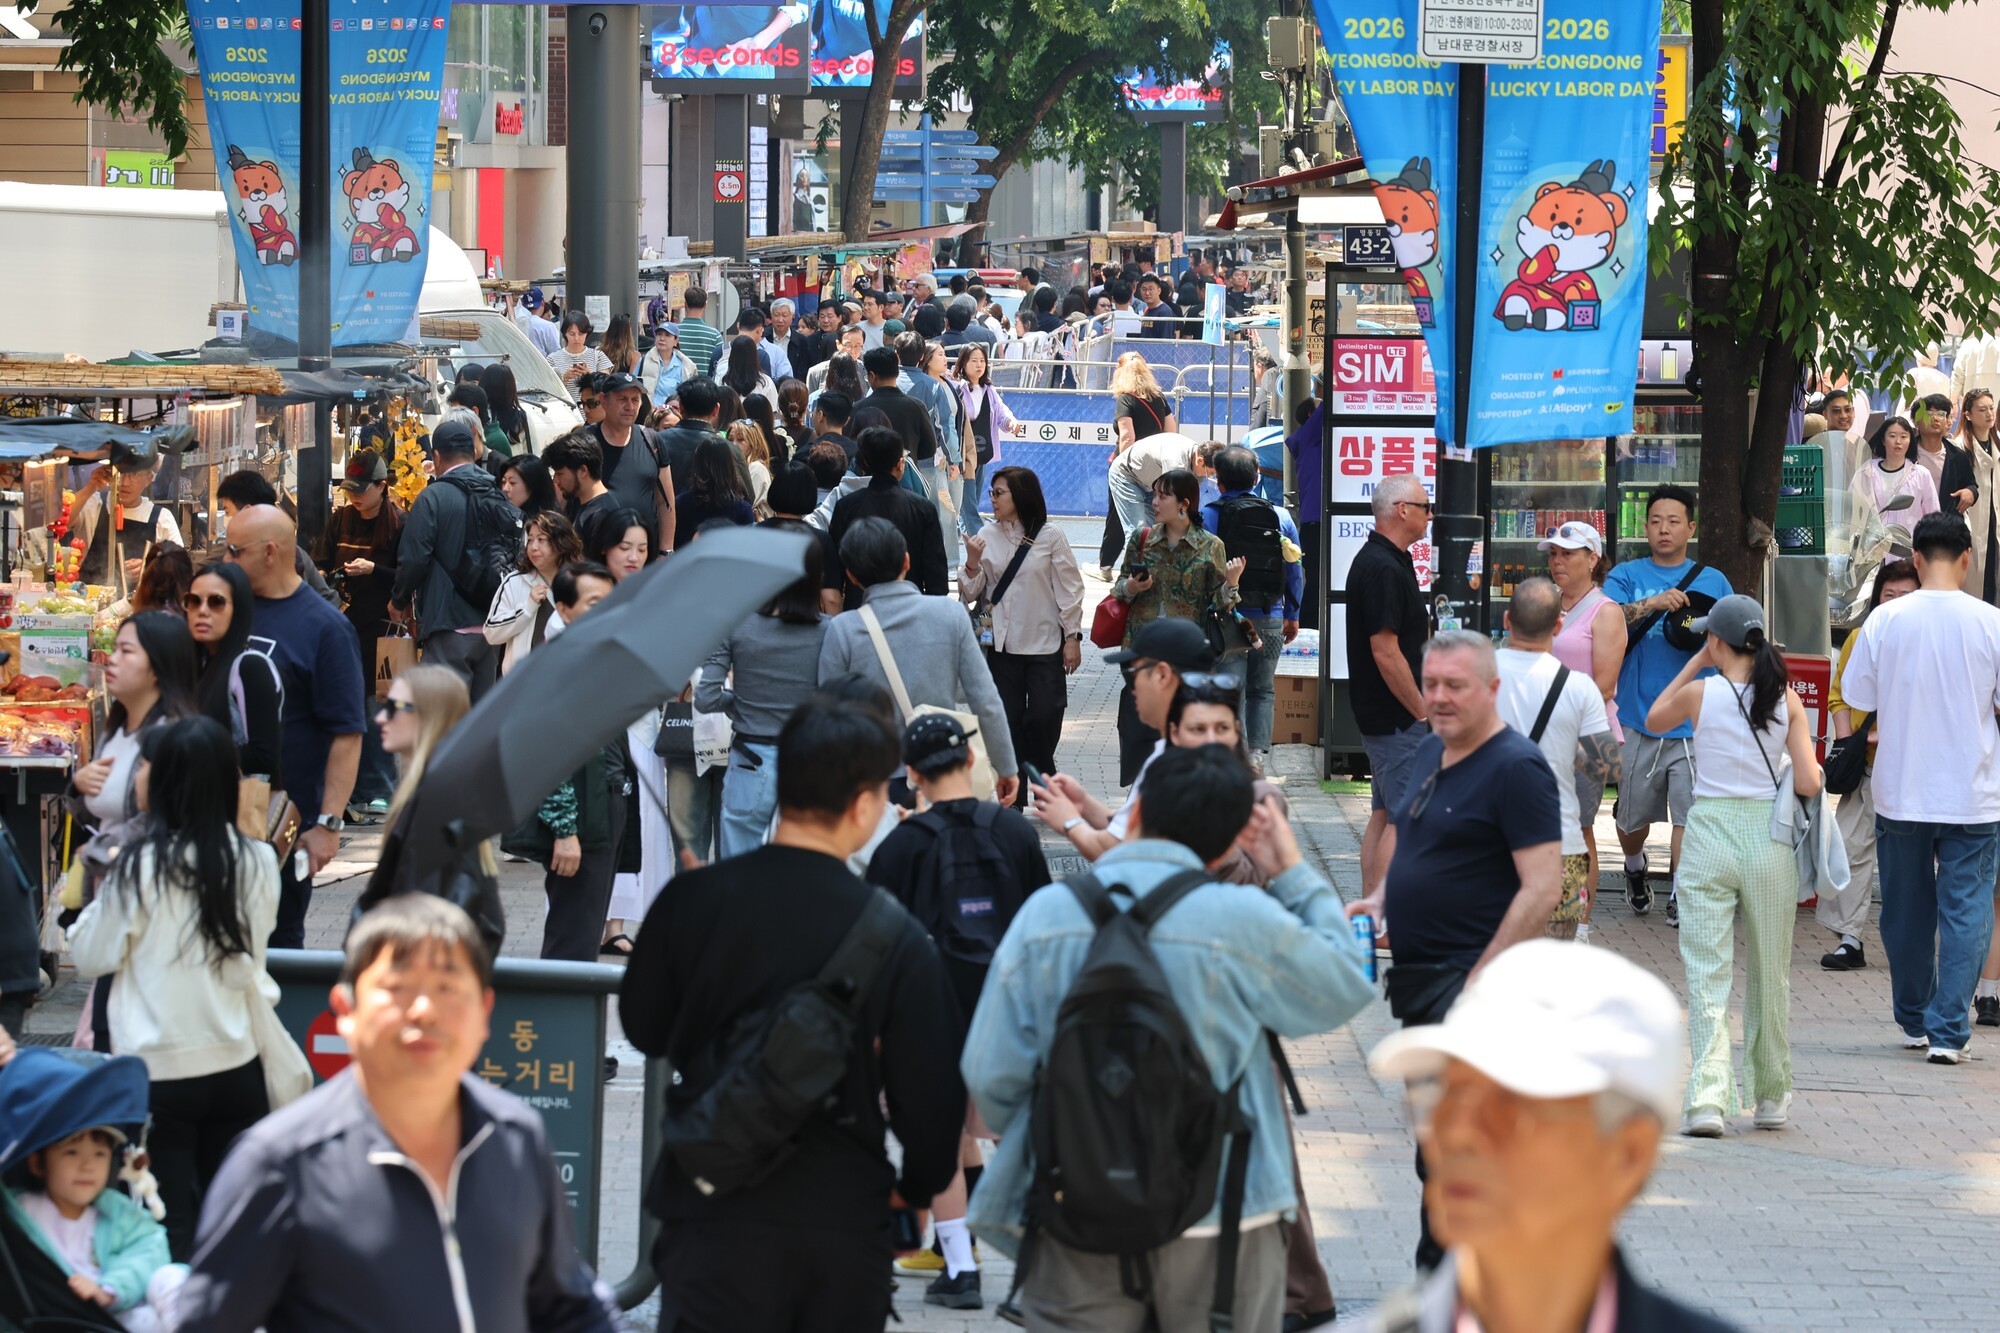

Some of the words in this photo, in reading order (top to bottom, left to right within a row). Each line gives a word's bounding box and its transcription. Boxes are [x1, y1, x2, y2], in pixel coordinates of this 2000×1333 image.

[1344, 17, 1405, 39] 2026
[1545, 18, 1610, 40] 2026
[1437, 38, 1523, 53] 남대문경찰서장
[660, 42, 677, 67] 8
[682, 42, 800, 67] seconds
[1361, 80, 1420, 96] LABOR
[1423, 82, 1456, 96] DAY
[1490, 81, 1551, 97] LUCKY
[1555, 81, 1615, 97] LABOR
[1619, 81, 1656, 97] DAY
[715, 163, 744, 172] 제한높이
[1359, 229, 1381, 237] 명동길
[1349, 237, 1391, 254] 43-2
[1388, 348, 1404, 356] LTE
[1337, 352, 1404, 383] SIM
[1501, 373, 1533, 381] HOSTED
[1490, 391, 1536, 400] ORGANIZED
[1537, 390, 1547, 398] BY
[1281, 700, 1315, 710] TEREA
